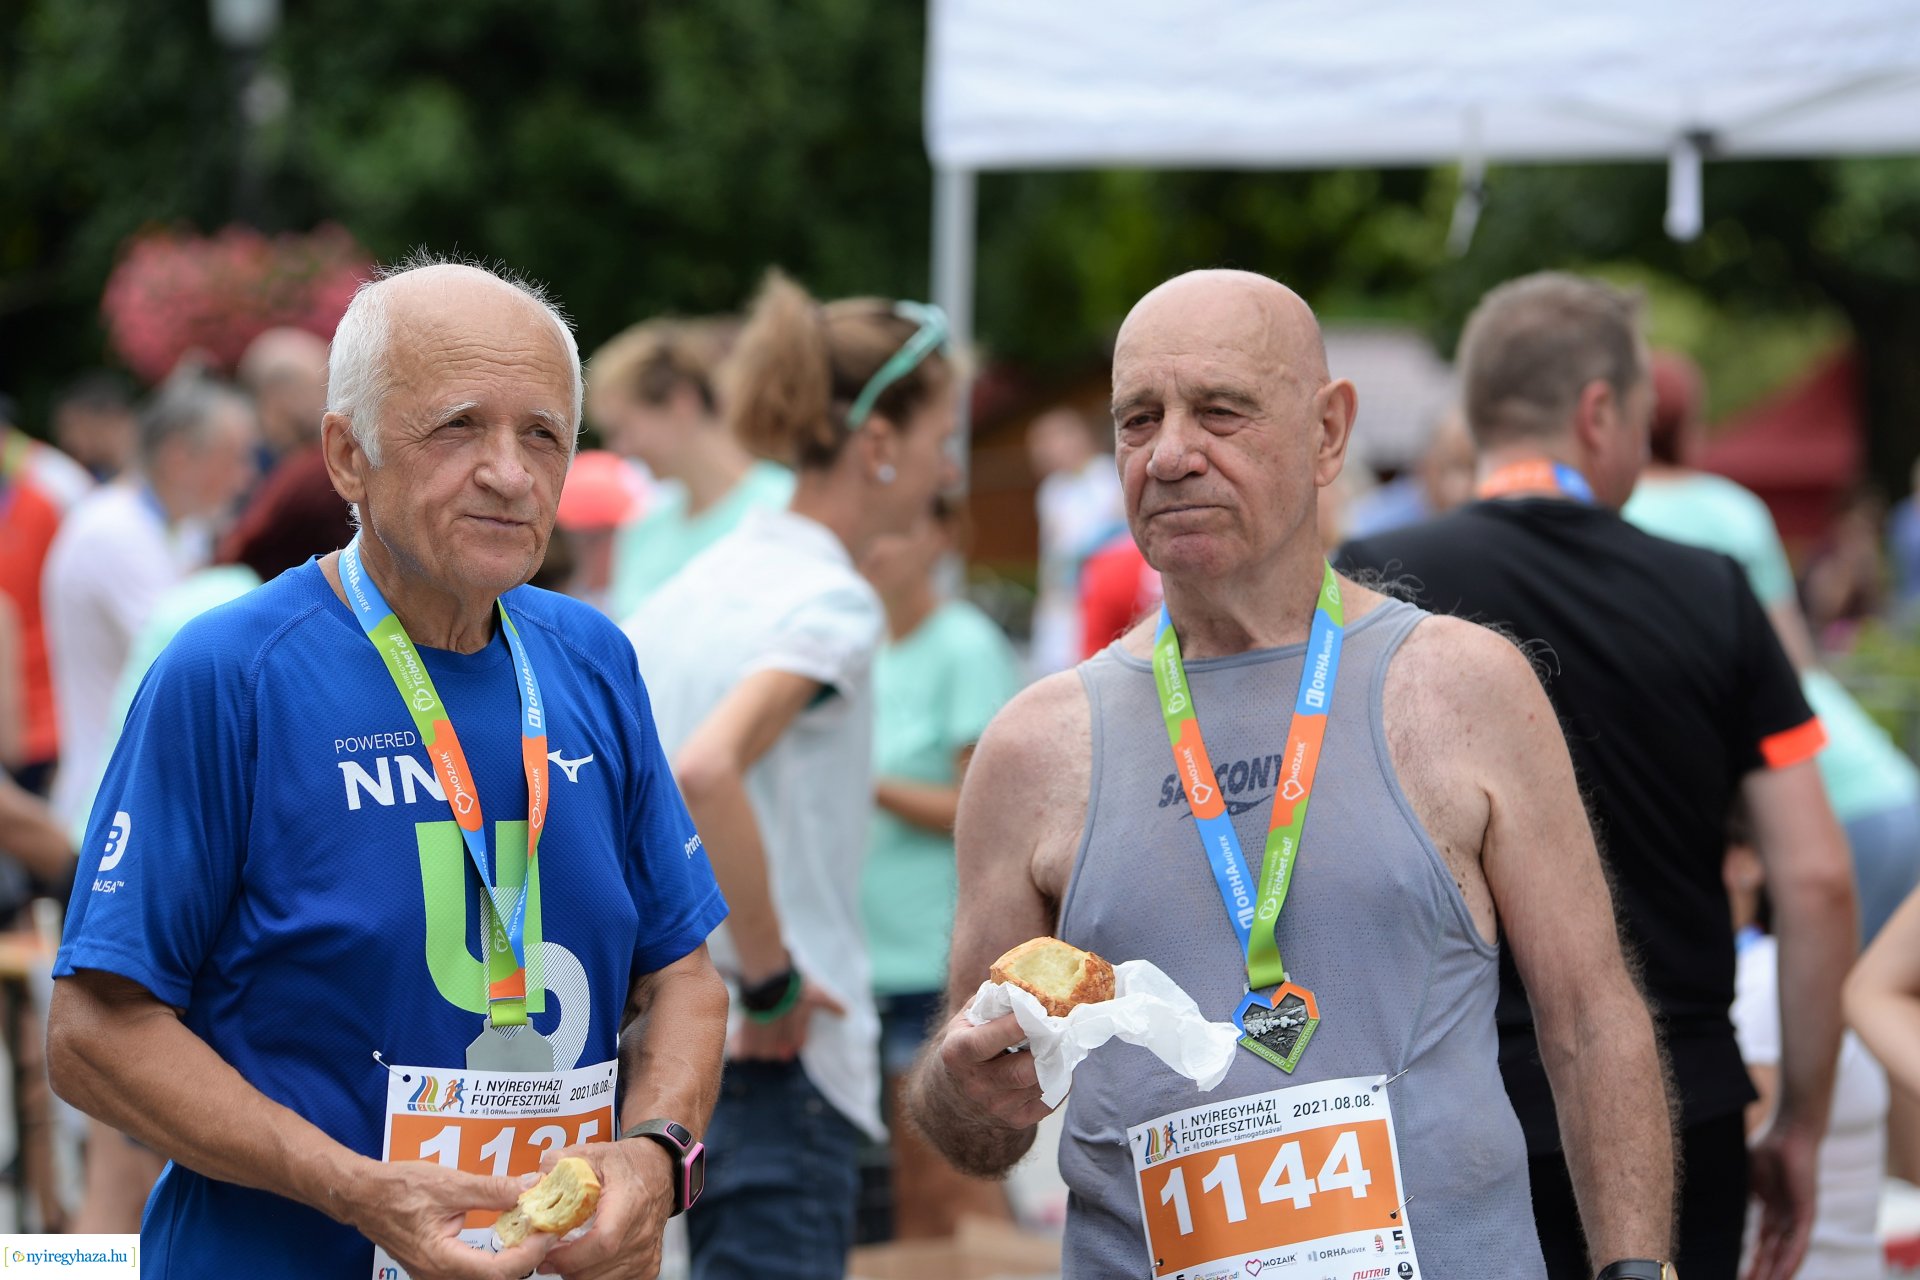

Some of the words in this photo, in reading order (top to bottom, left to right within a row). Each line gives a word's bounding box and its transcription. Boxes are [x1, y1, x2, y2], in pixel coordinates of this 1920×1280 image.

[388, 633, 407, 649] ad!
[400, 649, 425, 687] Többet
[334, 730, 416, 754] POWERED
[439, 751, 464, 794] MOZAIK
[1182, 747, 1201, 787] MOZAIK
[1290, 741, 1307, 781] MOZAIK
[337, 754, 450, 811] NN
[1158, 754, 1284, 808] SACONY
[471, 1090, 561, 1106] FUTÓFESZTIVÁL
[474, 1080, 482, 1091] I.
[486, 1078, 563, 1092] NYÍREGYHÁZI
[520, 1107, 560, 1116] támogatásával
[1181, 1118, 1188, 1130] I.
[1191, 1098, 1276, 1127] NYÍREGYHÁZI
[1293, 1094, 1375, 1118] 2021.08.08.
[1182, 1112, 1282, 1145] FUTÓFESZTIVÁL
[1234, 1125, 1283, 1141] támogatásával
[1159, 1130, 1372, 1236] 1144
[1262, 1254, 1297, 1268] MOZAIK
